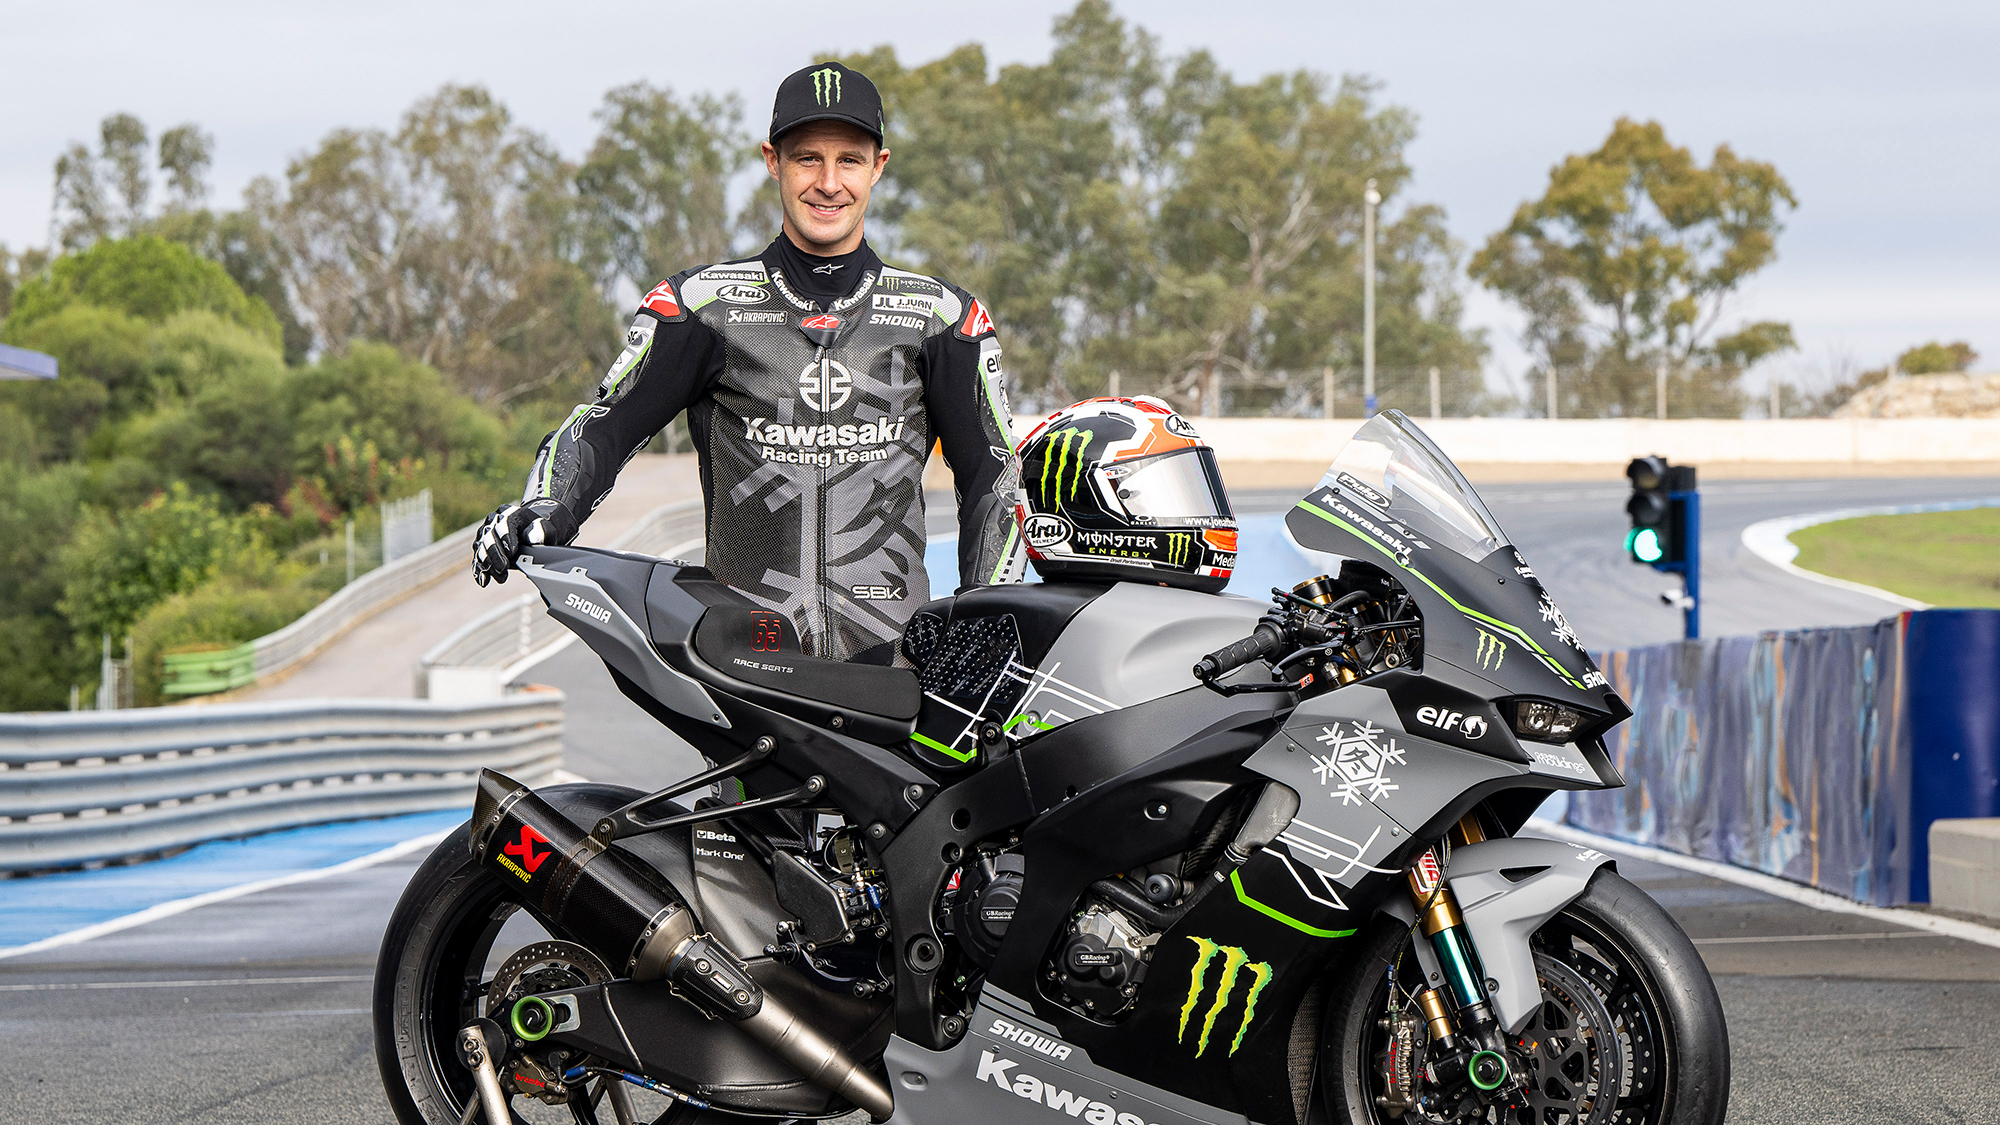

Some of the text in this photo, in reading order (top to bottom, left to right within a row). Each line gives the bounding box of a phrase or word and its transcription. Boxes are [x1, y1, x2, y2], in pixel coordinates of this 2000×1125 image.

[700, 270, 763, 282] Kawasaki
[900, 279, 942, 291] MONSTER
[720, 286, 763, 297] Arai
[771, 270, 814, 312] Kawasaki
[833, 272, 876, 311] Kawasaki
[869, 313, 926, 331] SHOWA
[986, 353, 1002, 373] el
[741, 416, 906, 447] Kawasaki
[761, 446, 888, 468] Racing Team
[1338, 474, 1381, 501] Puig
[1025, 518, 1065, 539] Arai
[1321, 493, 1413, 555] Kawasaki
[1077, 531, 1158, 550] MONSTER
[1088, 547, 1151, 558] ENERGY
[852, 585, 903, 600] SBK
[564, 592, 613, 624] SHOWA
[733, 657, 795, 674] RACE SEATS
[1416, 706, 1462, 732] elf
[706, 831, 736, 843] Beta
[696, 847, 720, 858] Mark
[988, 1018, 1073, 1062] SHOWA
[1389, 1041, 1398, 1084] brembo
[515, 1072, 546, 1088] brembo
